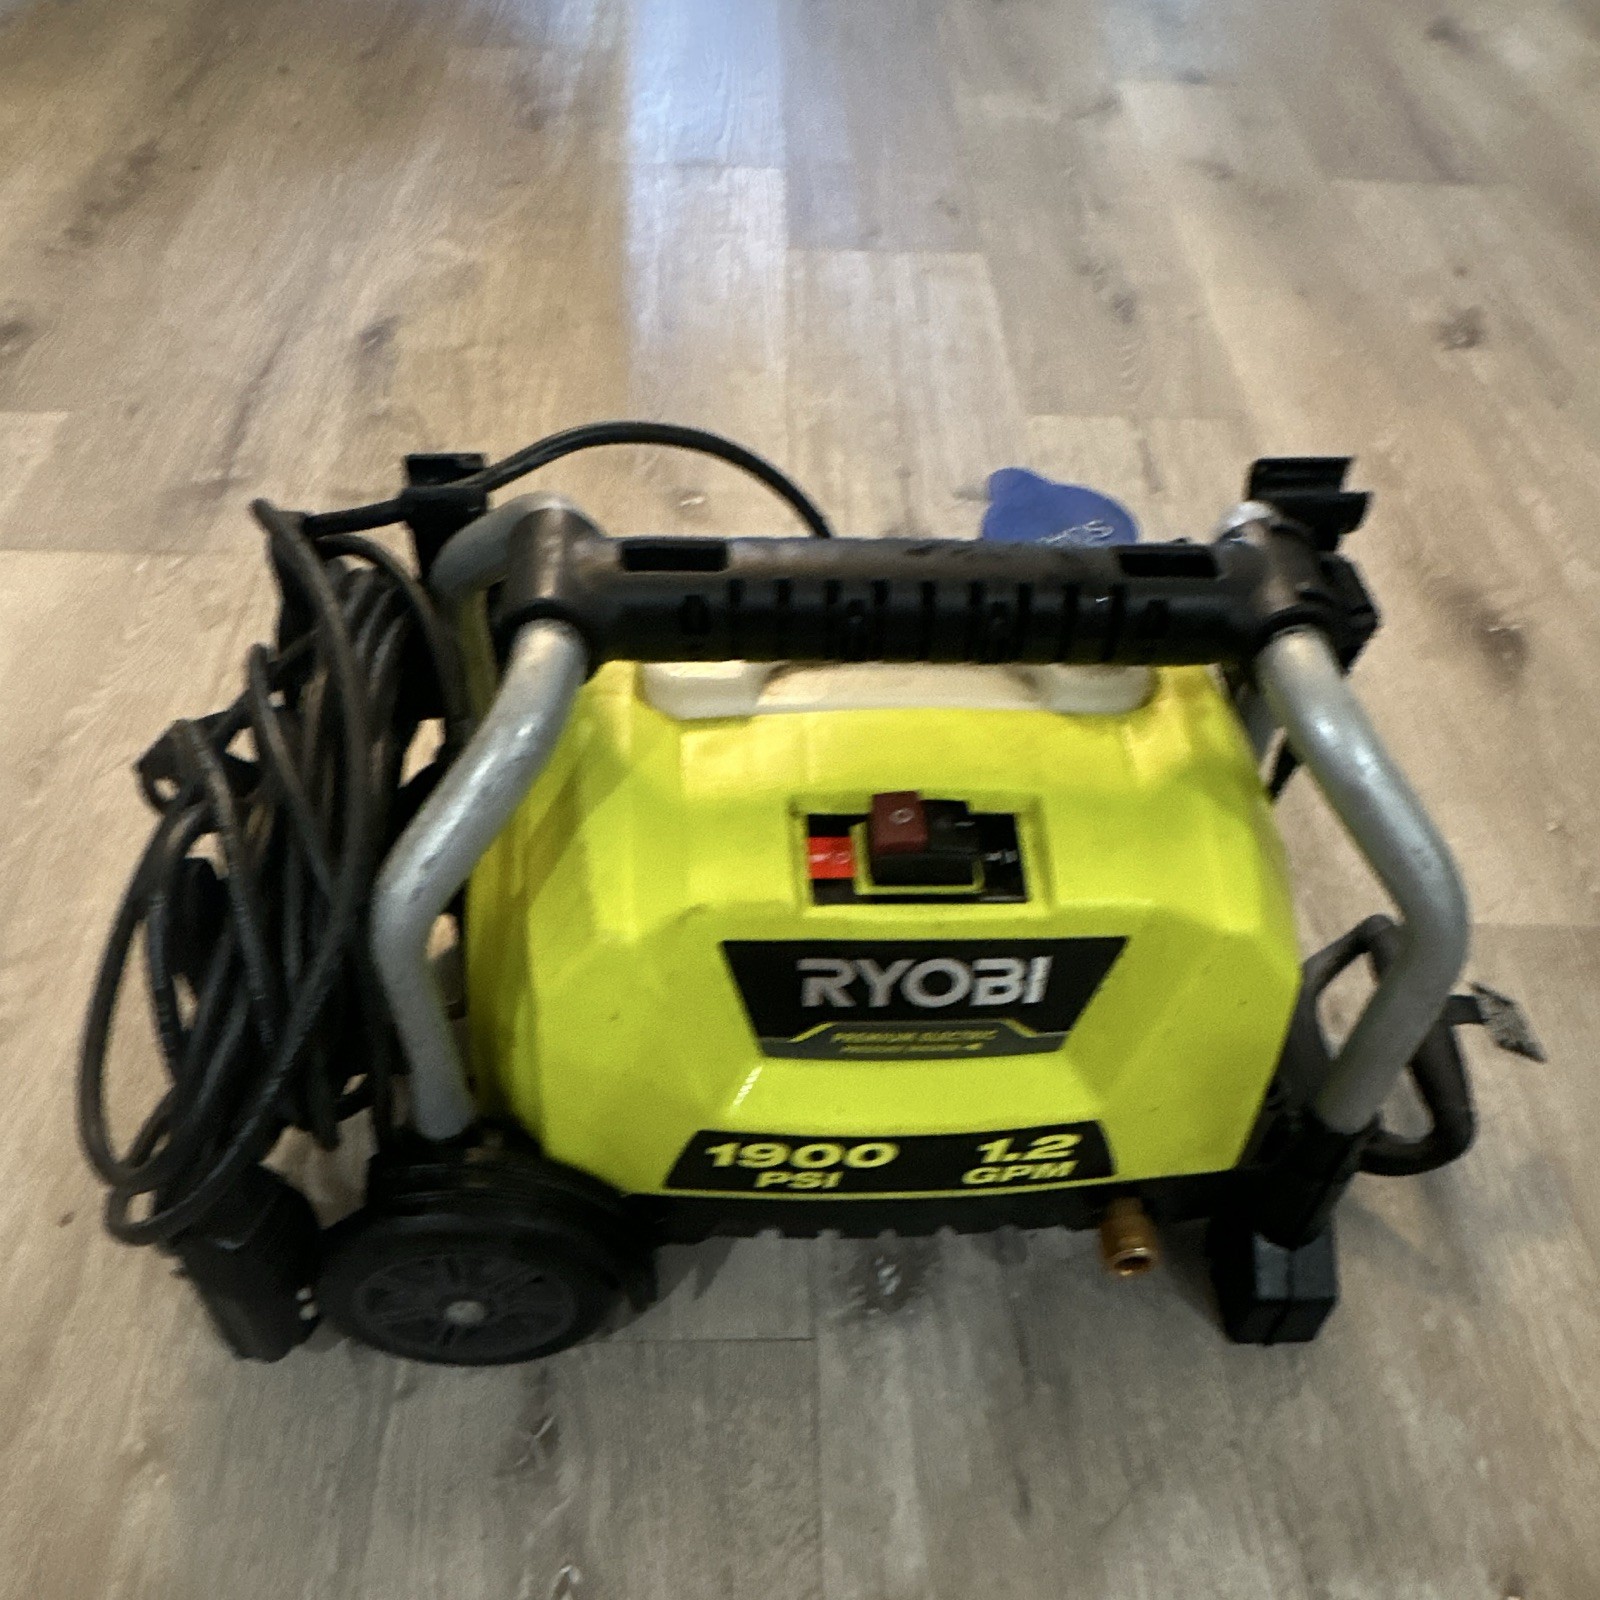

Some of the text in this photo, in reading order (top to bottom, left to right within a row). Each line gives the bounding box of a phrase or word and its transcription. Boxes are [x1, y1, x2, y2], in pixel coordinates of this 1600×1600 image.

[796, 955, 1053, 1008] RYOBI
[706, 1142, 898, 1169] 1900
[976, 1133, 1082, 1162] 1.2
[755, 1171, 843, 1189] PSI
[961, 1160, 1079, 1185] GPM
